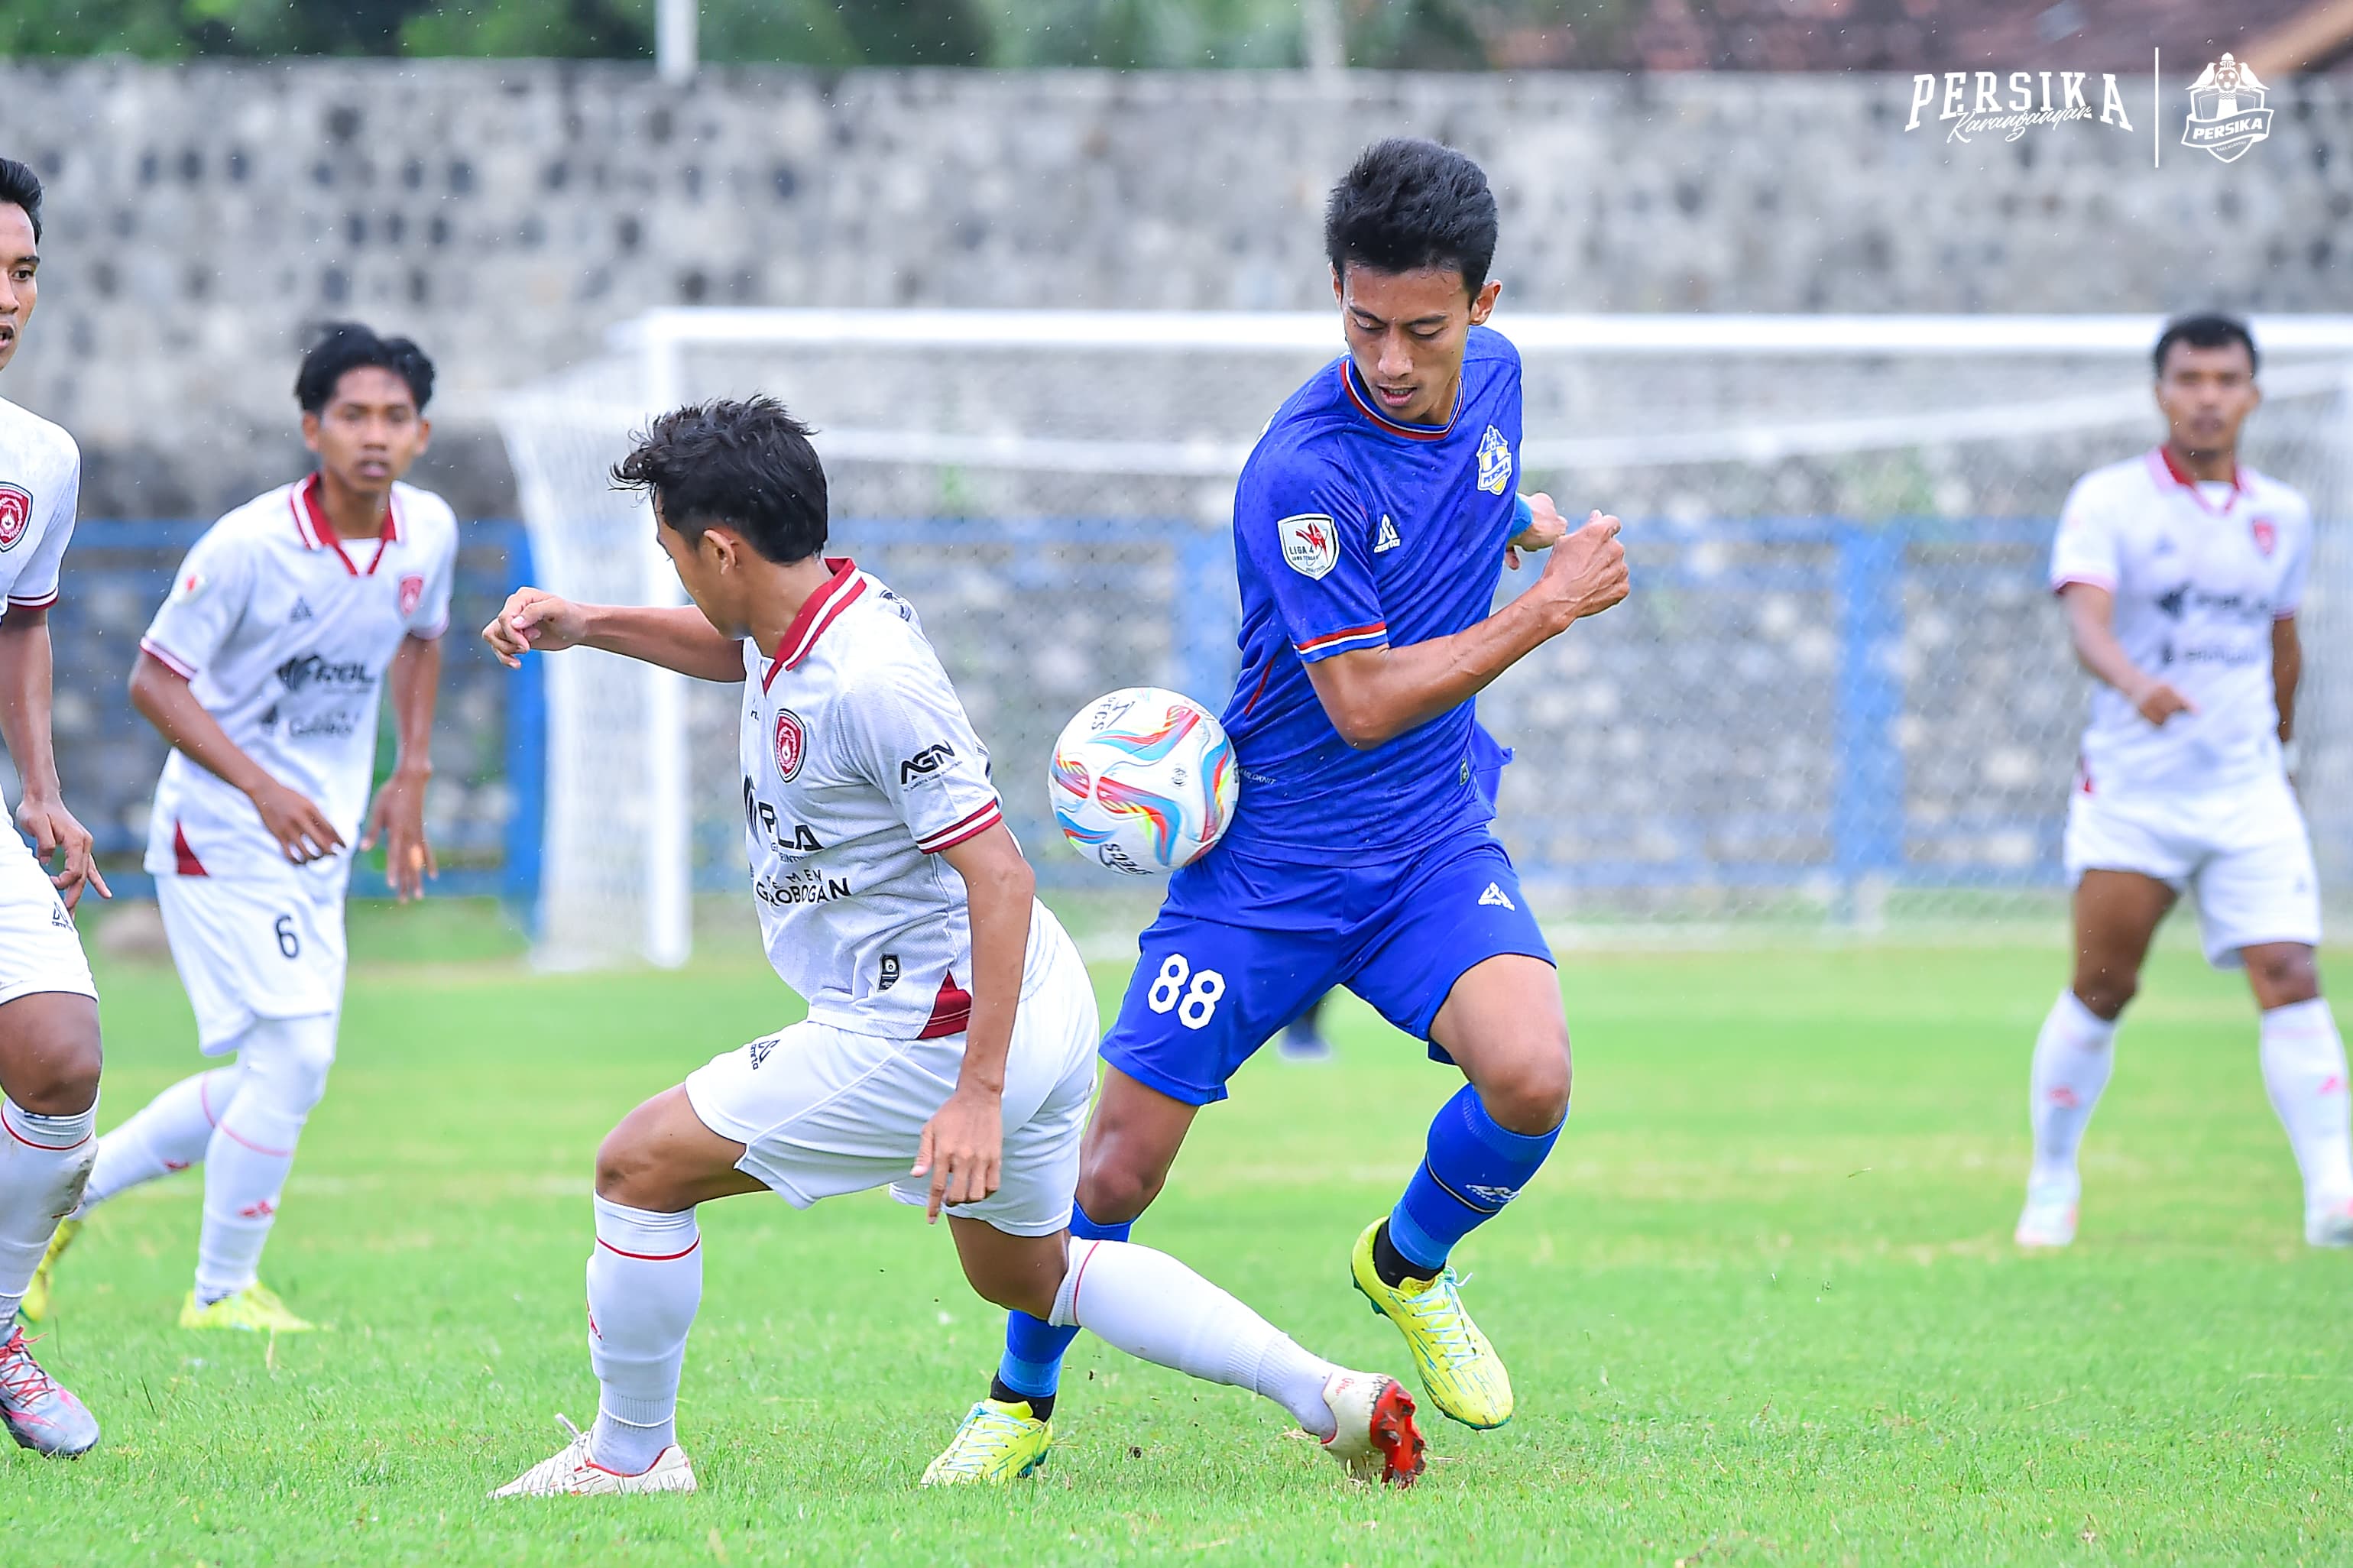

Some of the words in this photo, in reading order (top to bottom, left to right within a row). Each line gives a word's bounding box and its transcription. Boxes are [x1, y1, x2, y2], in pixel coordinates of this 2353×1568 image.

[1288, 546, 1308, 555] LIGA
[1309, 544, 1314, 554] 4
[900, 739, 955, 785] AGN
[275, 915, 300, 960] 6
[1147, 953, 1227, 1031] 88
